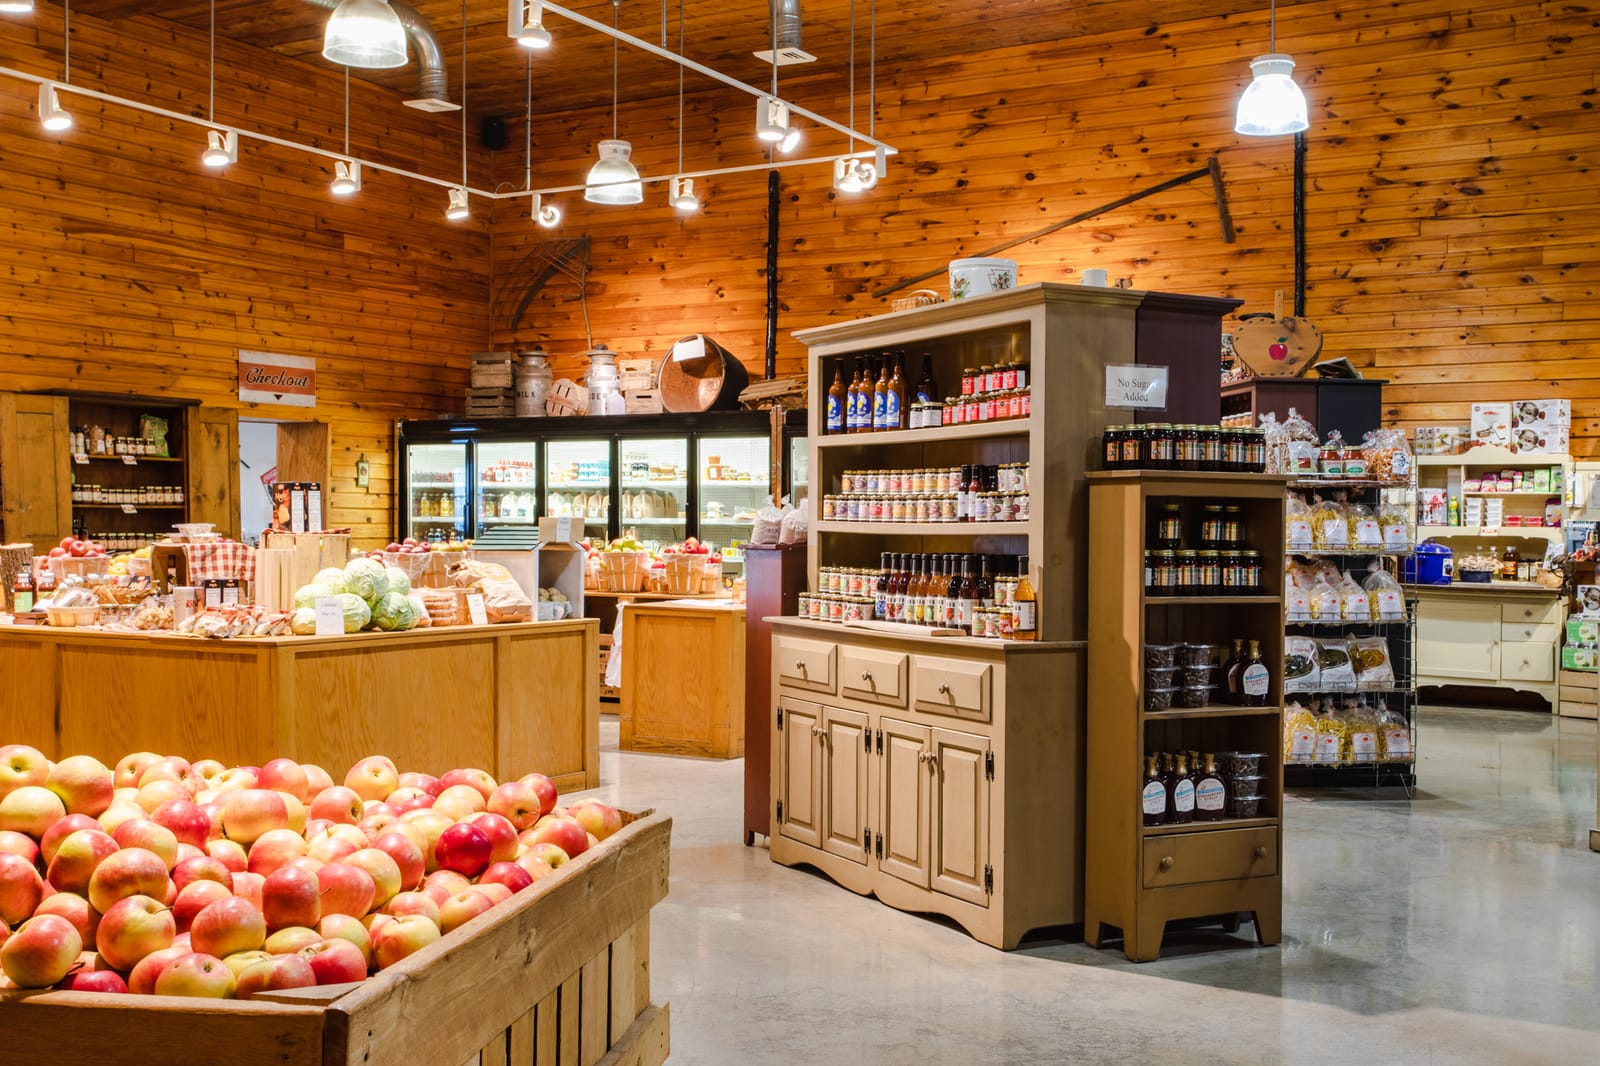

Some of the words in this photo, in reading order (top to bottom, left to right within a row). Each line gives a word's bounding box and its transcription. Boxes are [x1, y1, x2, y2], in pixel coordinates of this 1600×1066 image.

[246, 367, 309, 387] Checkout
[1118, 377, 1130, 388] No
[1131, 378, 1152, 391] Suga
[1123, 392, 1149, 402] Added
